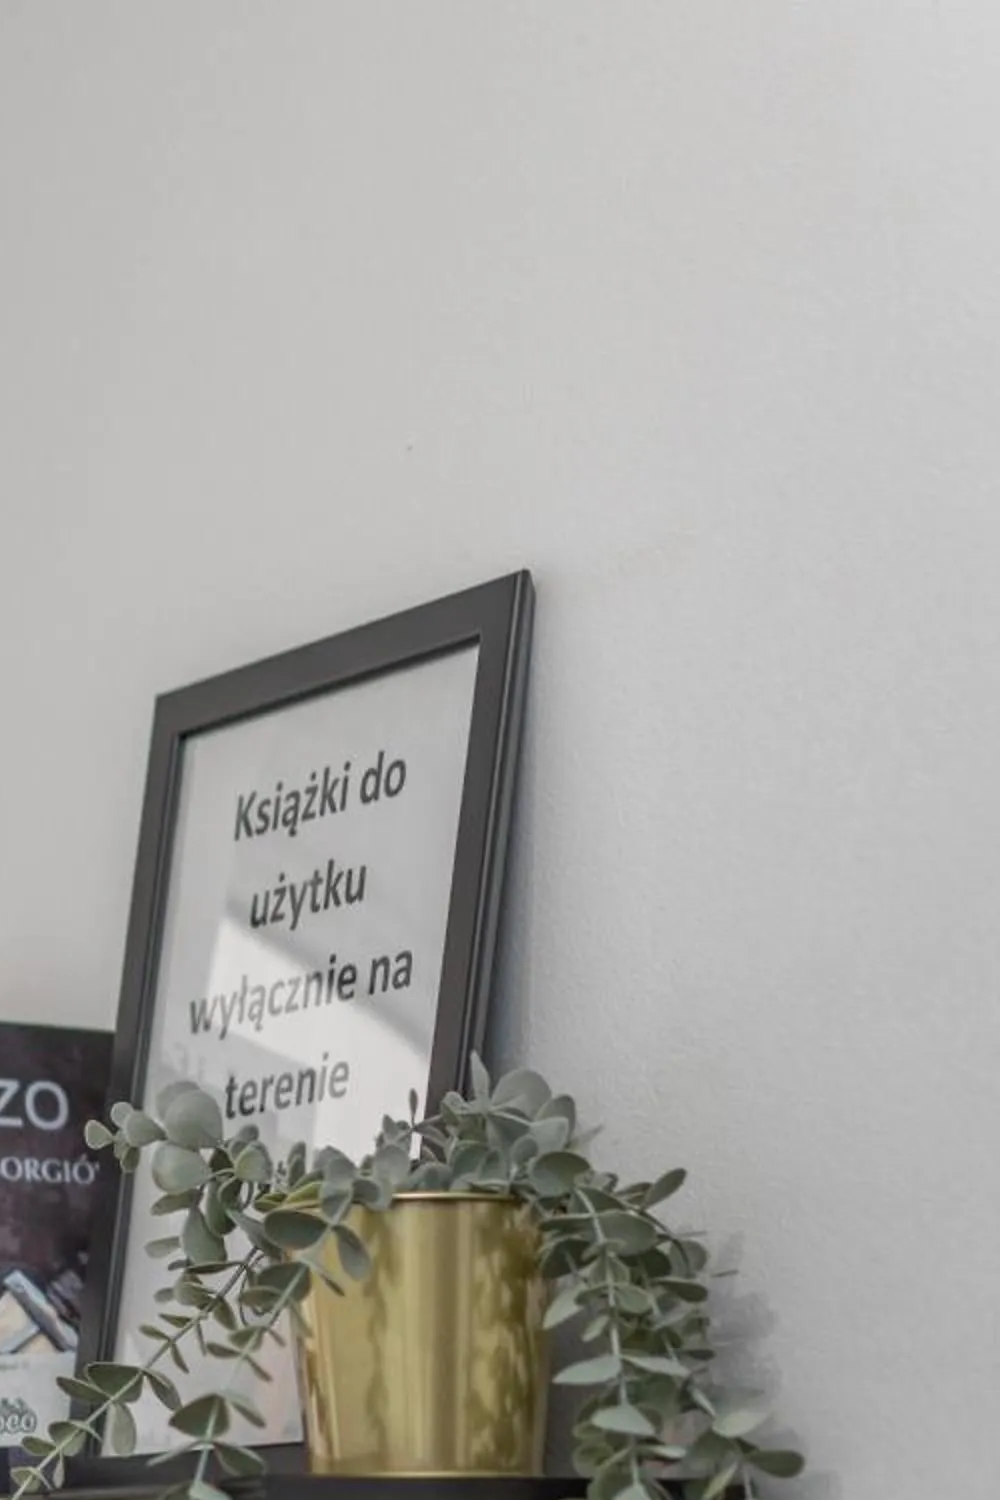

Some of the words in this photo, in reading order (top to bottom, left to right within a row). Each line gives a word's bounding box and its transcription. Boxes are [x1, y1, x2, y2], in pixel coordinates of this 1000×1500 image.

[234, 760, 351, 842] Książki
[359, 749, 407, 805] do
[249, 858, 366, 931] użytku
[189, 953, 358, 1041] wyłącznie
[368, 949, 414, 996] na
[224, 1052, 351, 1120] terenie
